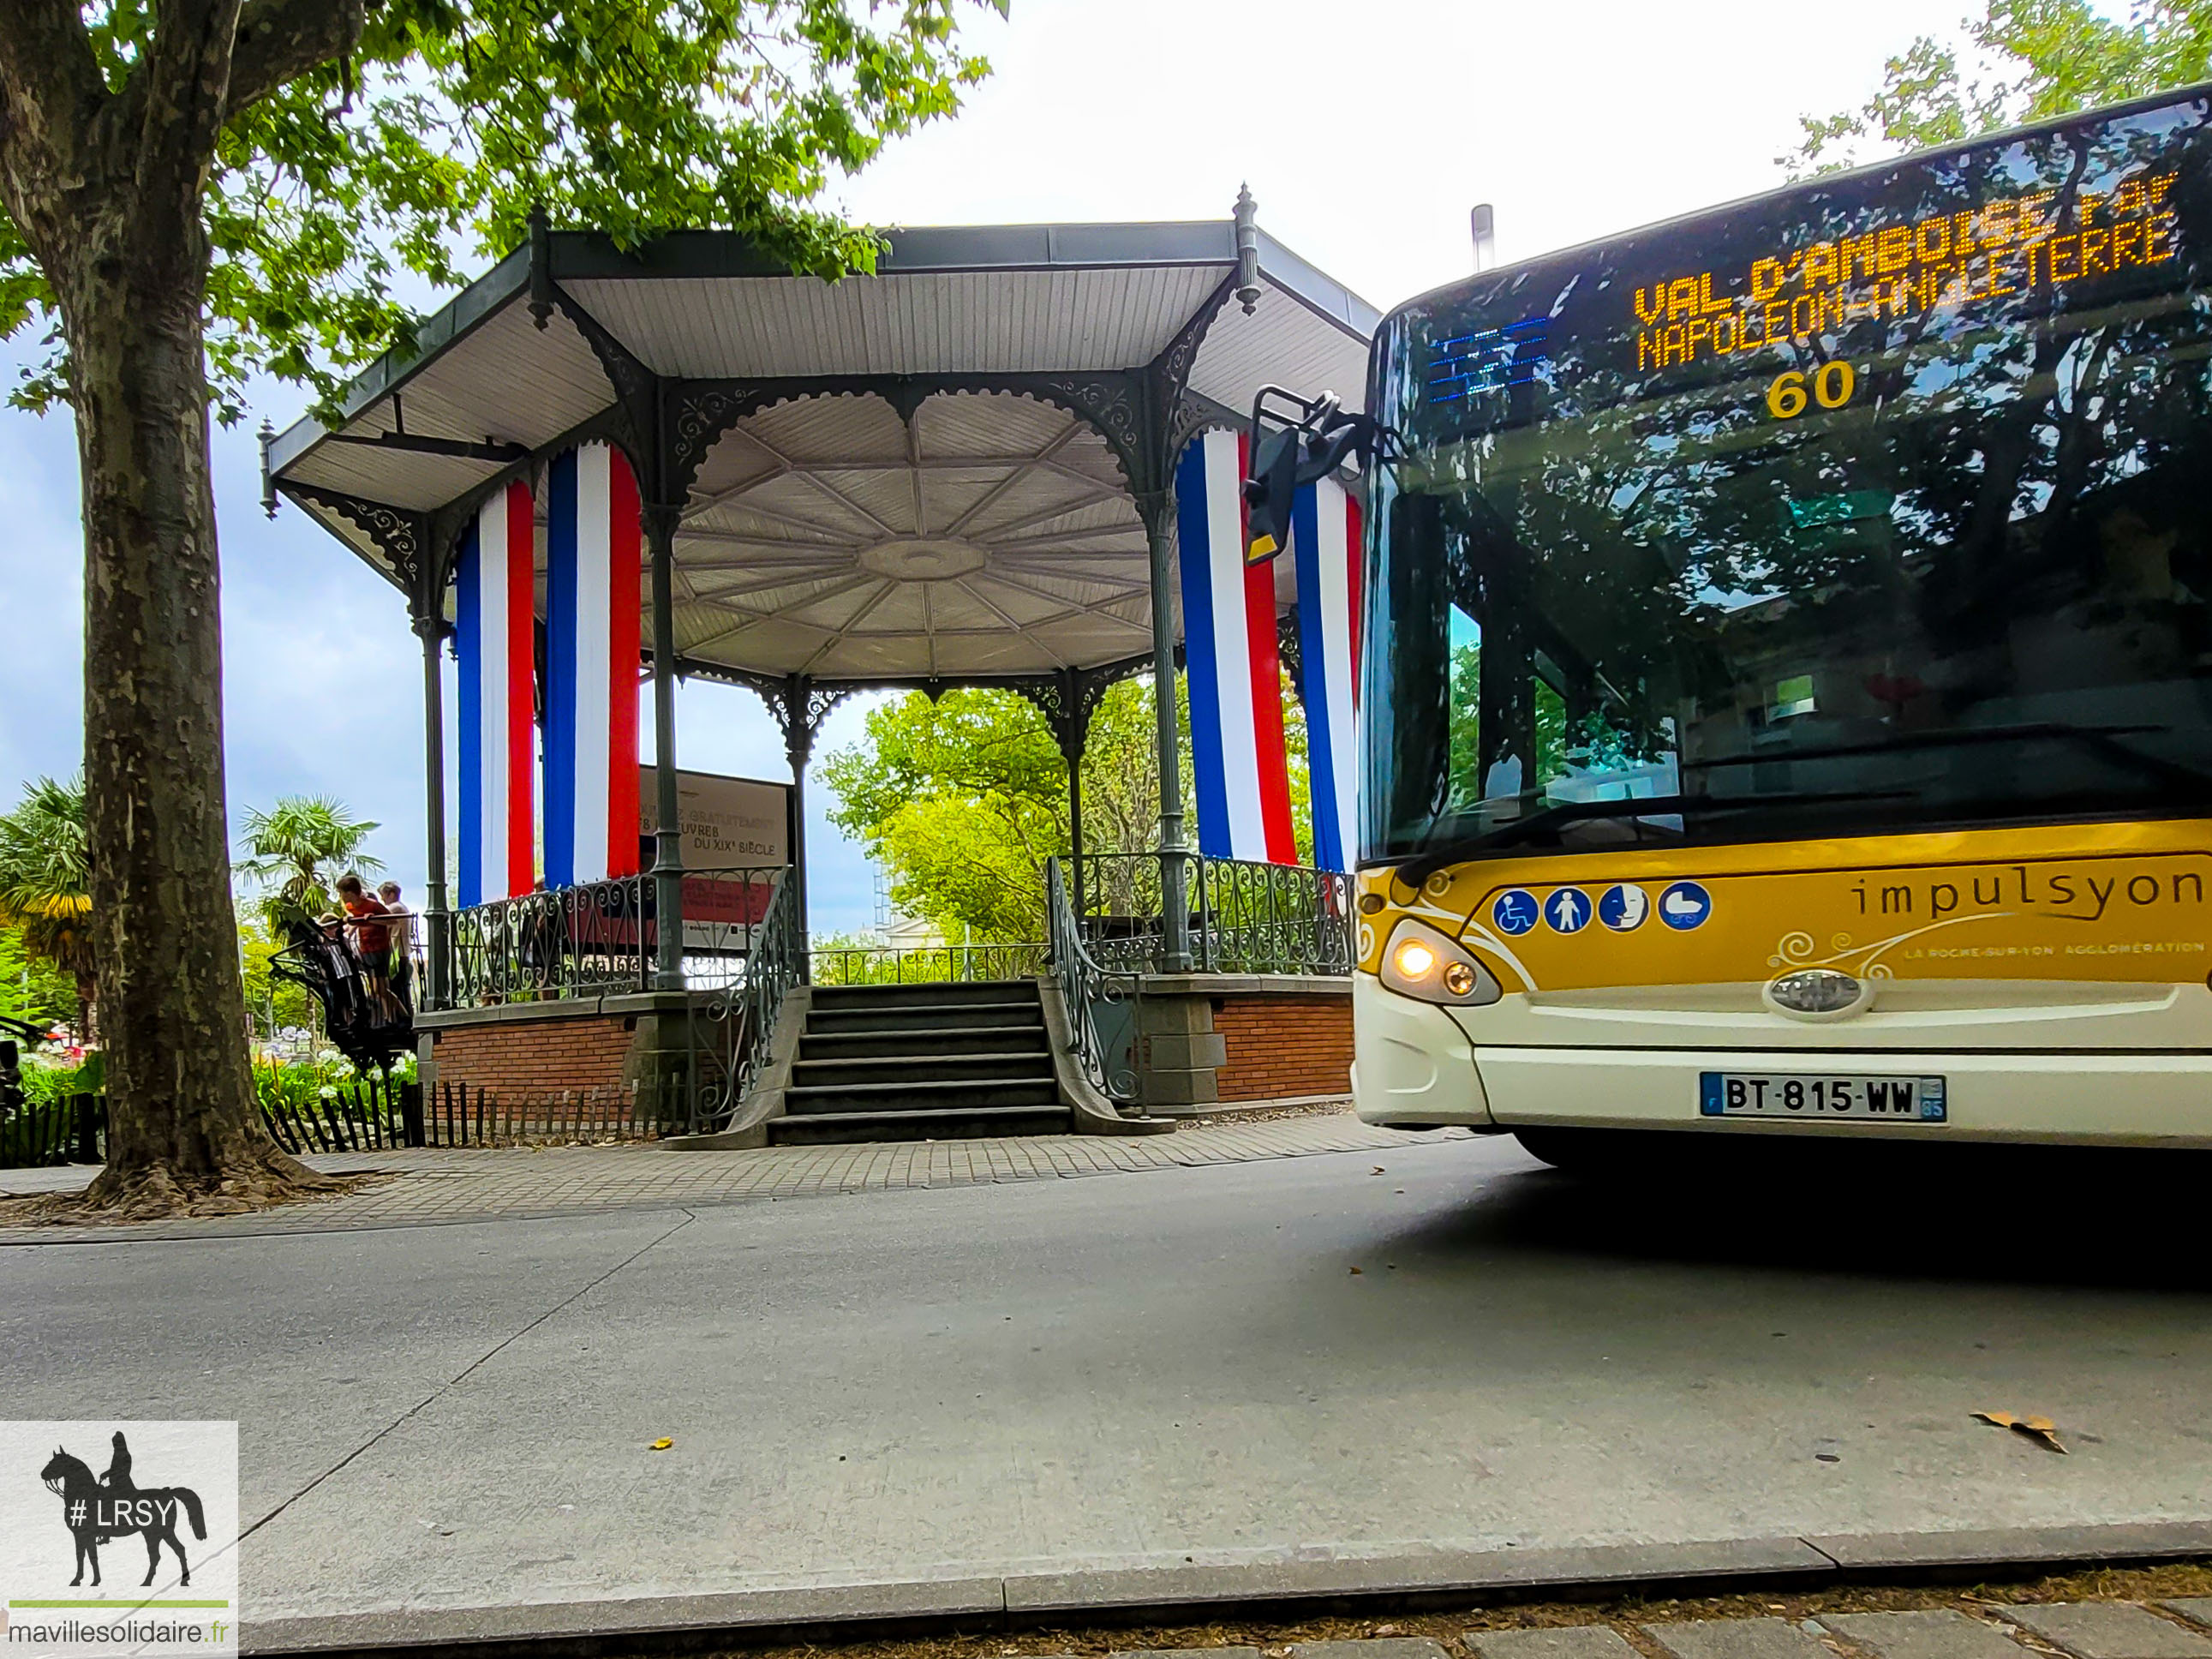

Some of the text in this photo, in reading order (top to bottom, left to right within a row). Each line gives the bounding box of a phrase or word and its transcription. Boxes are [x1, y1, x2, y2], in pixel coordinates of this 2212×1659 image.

[1635, 273, 1732, 326] VAL
[1751, 190, 2056, 301] D'AMBOISE
[1638, 211, 2175, 371] NAPOLEON-ANGLETERRE
[1767, 360, 1854, 418] 60
[694, 837, 710, 849] DU
[738, 841, 775, 856] SIÈCLE
[1850, 865, 2203, 921] impulsyon
[1904, 949, 1922, 959] LA
[1726, 1080, 1913, 1113] BT-815-WW
